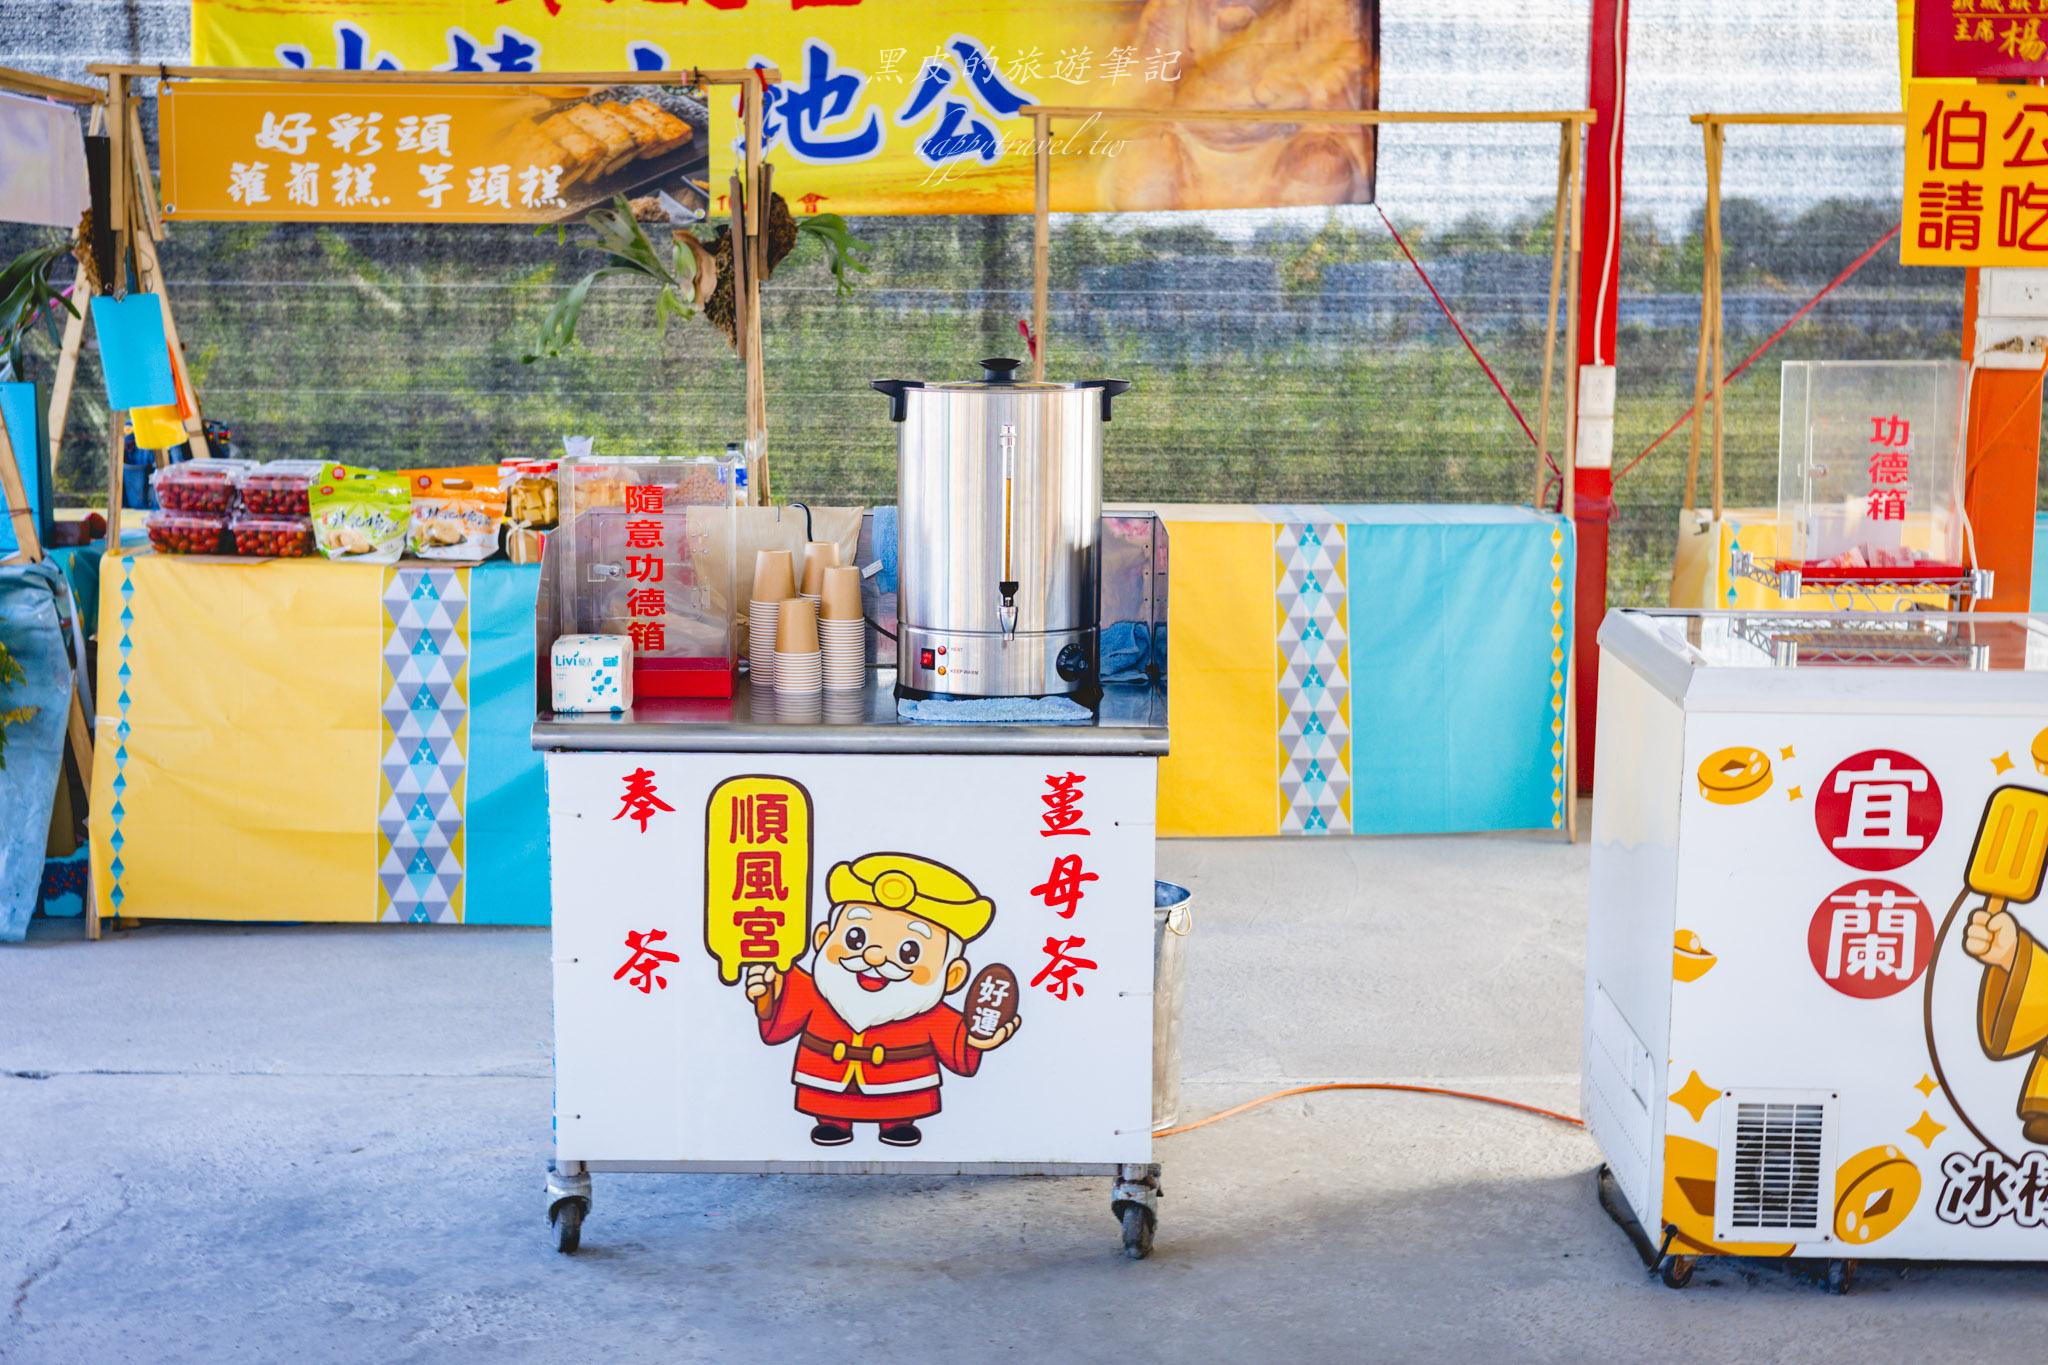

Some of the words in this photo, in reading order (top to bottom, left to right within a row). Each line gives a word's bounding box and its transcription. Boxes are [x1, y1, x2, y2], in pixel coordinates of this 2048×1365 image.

[255, 111, 453, 157] 好彩頭
[1866, 414, 1911, 521] 功德箱
[625, 485, 667, 651] 隨意功德箱
[729, 793, 789, 958] 順風宮
[1031, 771, 1099, 1001] 薑母茶
[1824, 757, 1930, 981] 宜蘭
[971, 975, 1009, 1036] 好運
